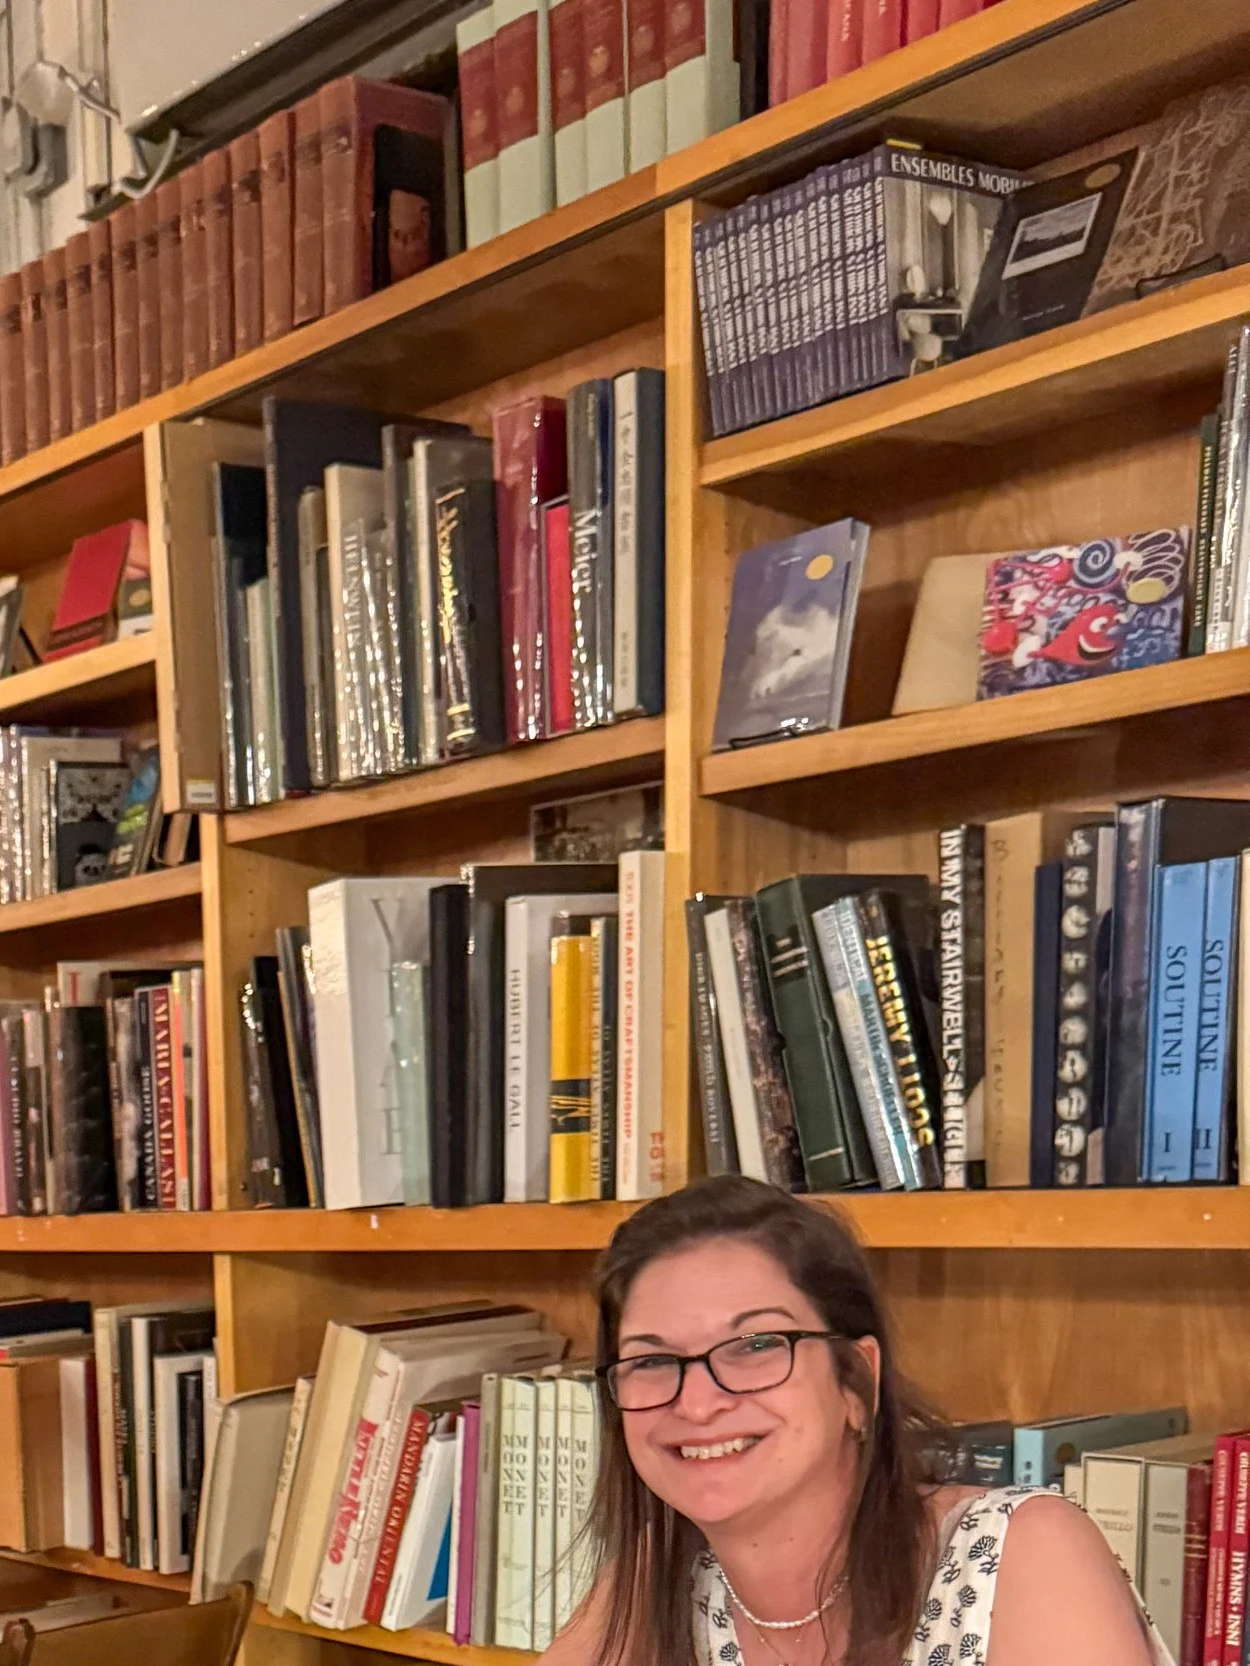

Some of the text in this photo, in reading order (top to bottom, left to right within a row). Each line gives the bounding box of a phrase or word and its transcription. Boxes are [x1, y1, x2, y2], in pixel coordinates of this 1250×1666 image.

[891, 152, 976, 188] ENSEMBLES
[573, 510, 599, 593] Meier
[941, 858, 962, 904] MY
[622, 911, 634, 1140] THE ART OF CRAFTSMANSHIP
[865, 935, 912, 1043] JEREMY
[1161, 946, 1188, 1077] SOUTINE
[1199, 940, 1224, 1073] SOUTINE
[507, 969, 521, 1133] HUBERT LE GALL
[154, 1000, 174, 1195] MARIA CALLAS
[373, 1418, 426, 1585] MANDARIN ORIENTAL
[514, 1435, 528, 1516] MONET
[536, 1436, 549, 1517] MONET
[556, 1437, 570, 1518] MONET
[574, 1440, 588, 1521] MONET
[1228, 1551, 1247, 1604] HYMNS
[1225, 1613, 1243, 1647] INNI
